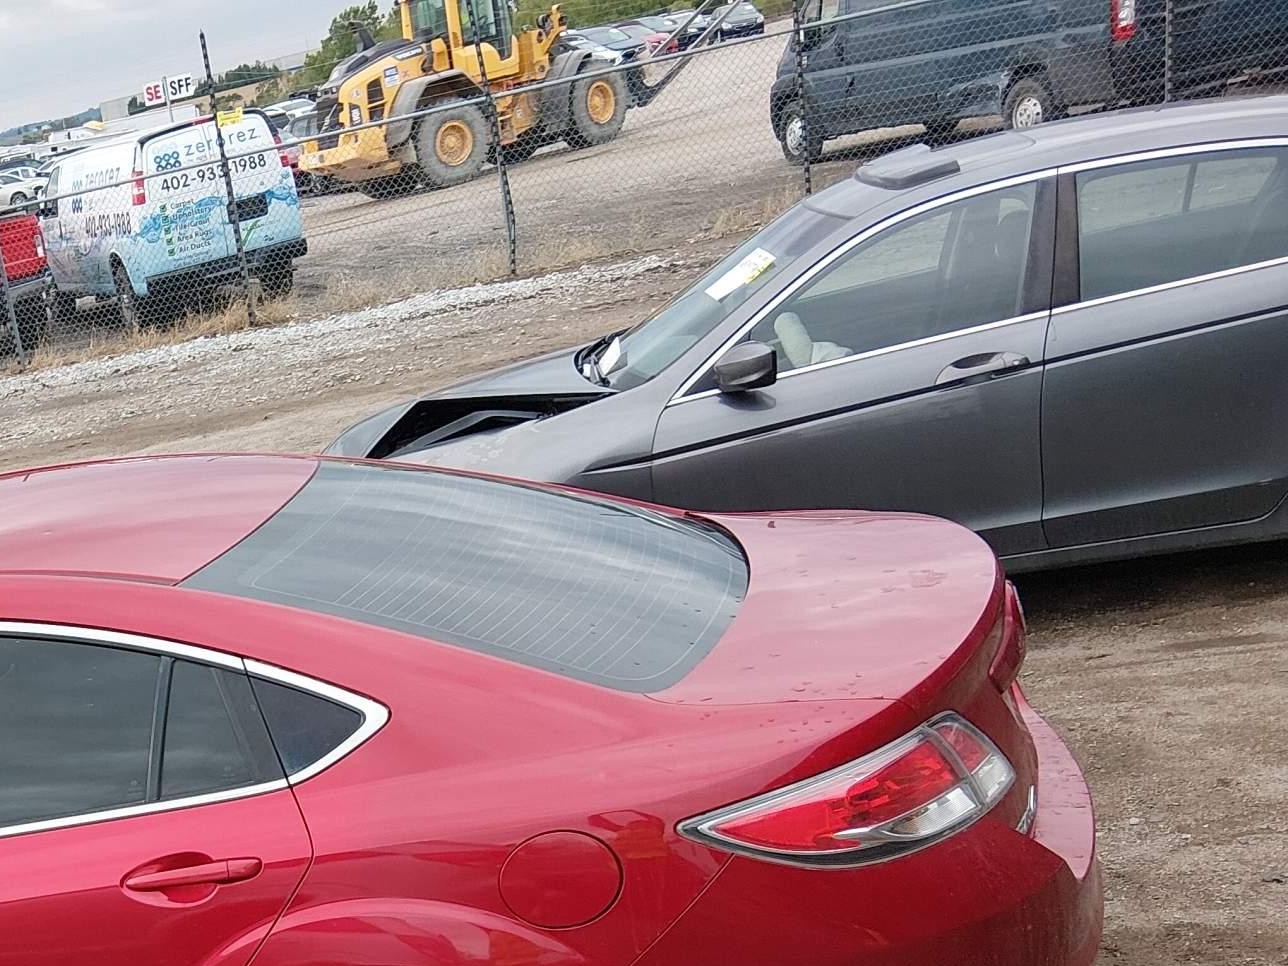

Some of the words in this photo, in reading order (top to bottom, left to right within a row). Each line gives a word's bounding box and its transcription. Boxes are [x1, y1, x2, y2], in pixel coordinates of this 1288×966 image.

[145, 84, 162, 102] SE
[169, 76, 192, 96] SFF
[183, 127, 259, 157] zerorez
[161, 154, 266, 192] 402-933-1988
